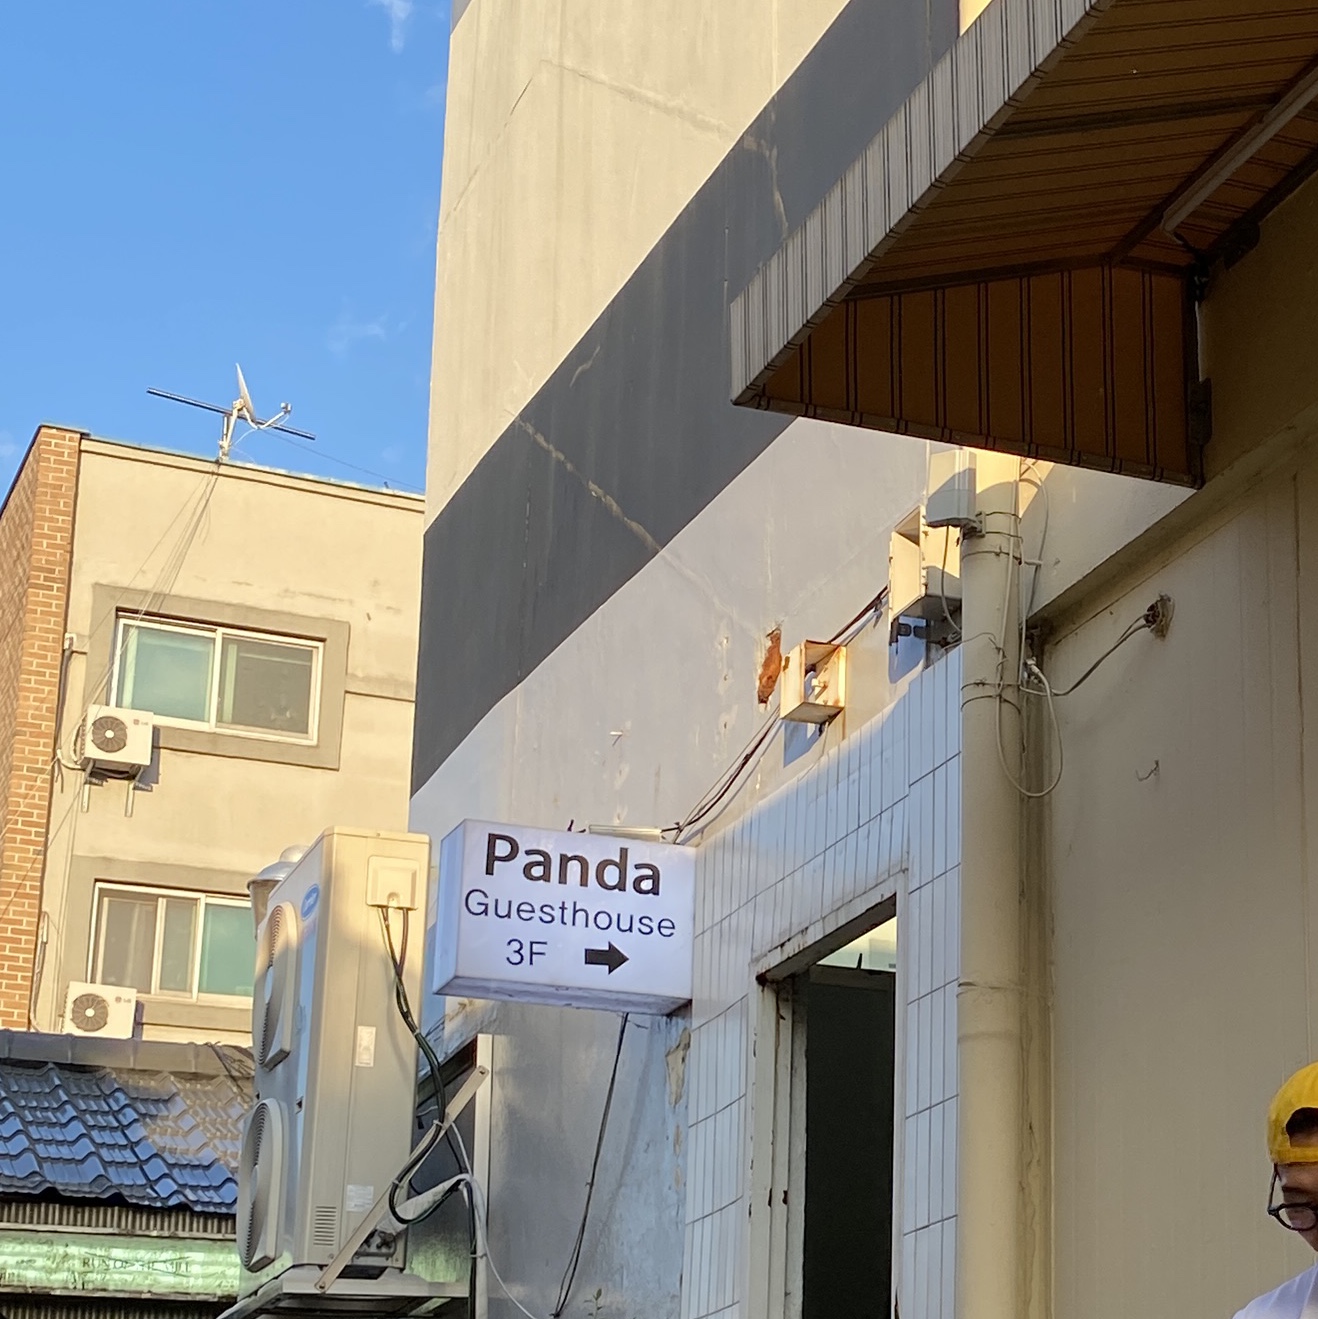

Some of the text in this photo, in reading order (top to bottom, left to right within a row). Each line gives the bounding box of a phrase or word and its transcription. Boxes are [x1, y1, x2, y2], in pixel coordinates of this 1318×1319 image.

[485, 832, 661, 896] Panda
[464, 888, 677, 938] Guesthouse
[505, 938, 548, 966] 3F
